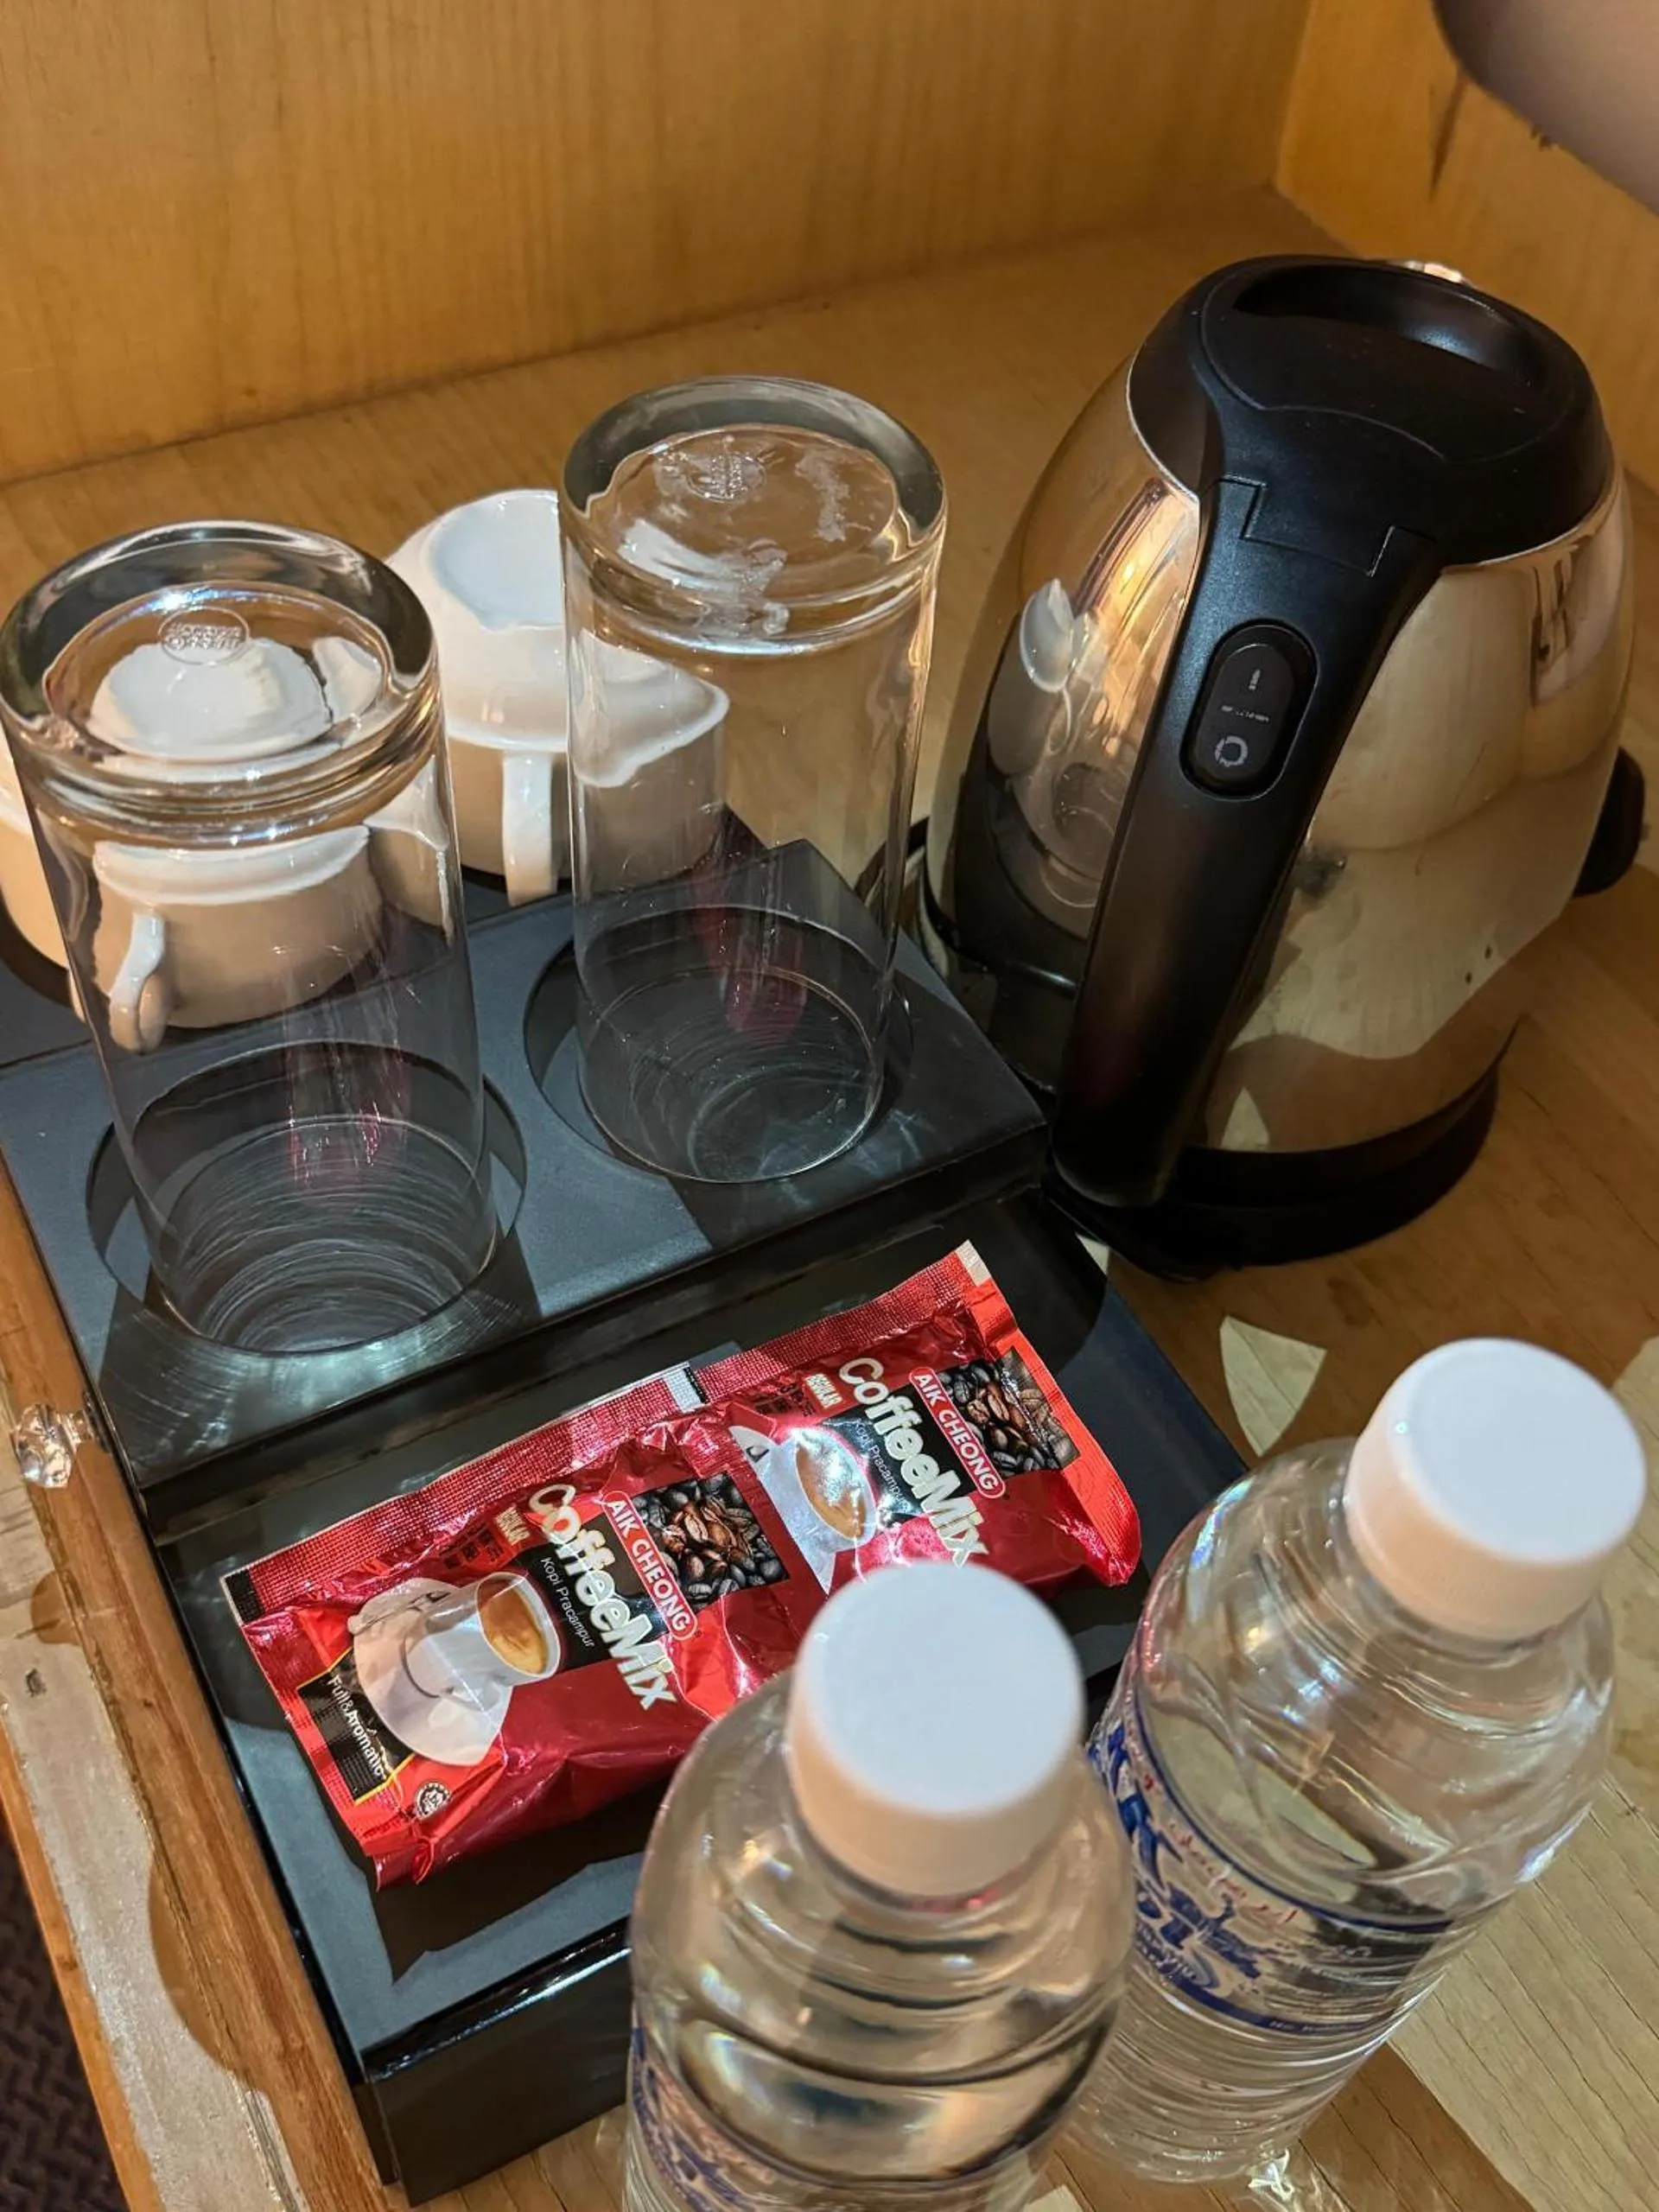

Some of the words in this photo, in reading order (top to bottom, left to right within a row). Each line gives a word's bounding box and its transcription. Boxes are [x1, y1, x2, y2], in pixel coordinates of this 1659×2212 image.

[839, 1357, 988, 1567] CoffeeMix
[914, 1374, 945, 1407] AIK
[938, 1408, 999, 1491] CHEONG
[529, 1484, 677, 1711] CoffeeMix
[540, 1557, 562, 1589] Kopi
[556, 1585, 595, 1648] Pracampur
[607, 1499, 639, 1539] AIK
[632, 1538, 690, 1633] CHEONG
